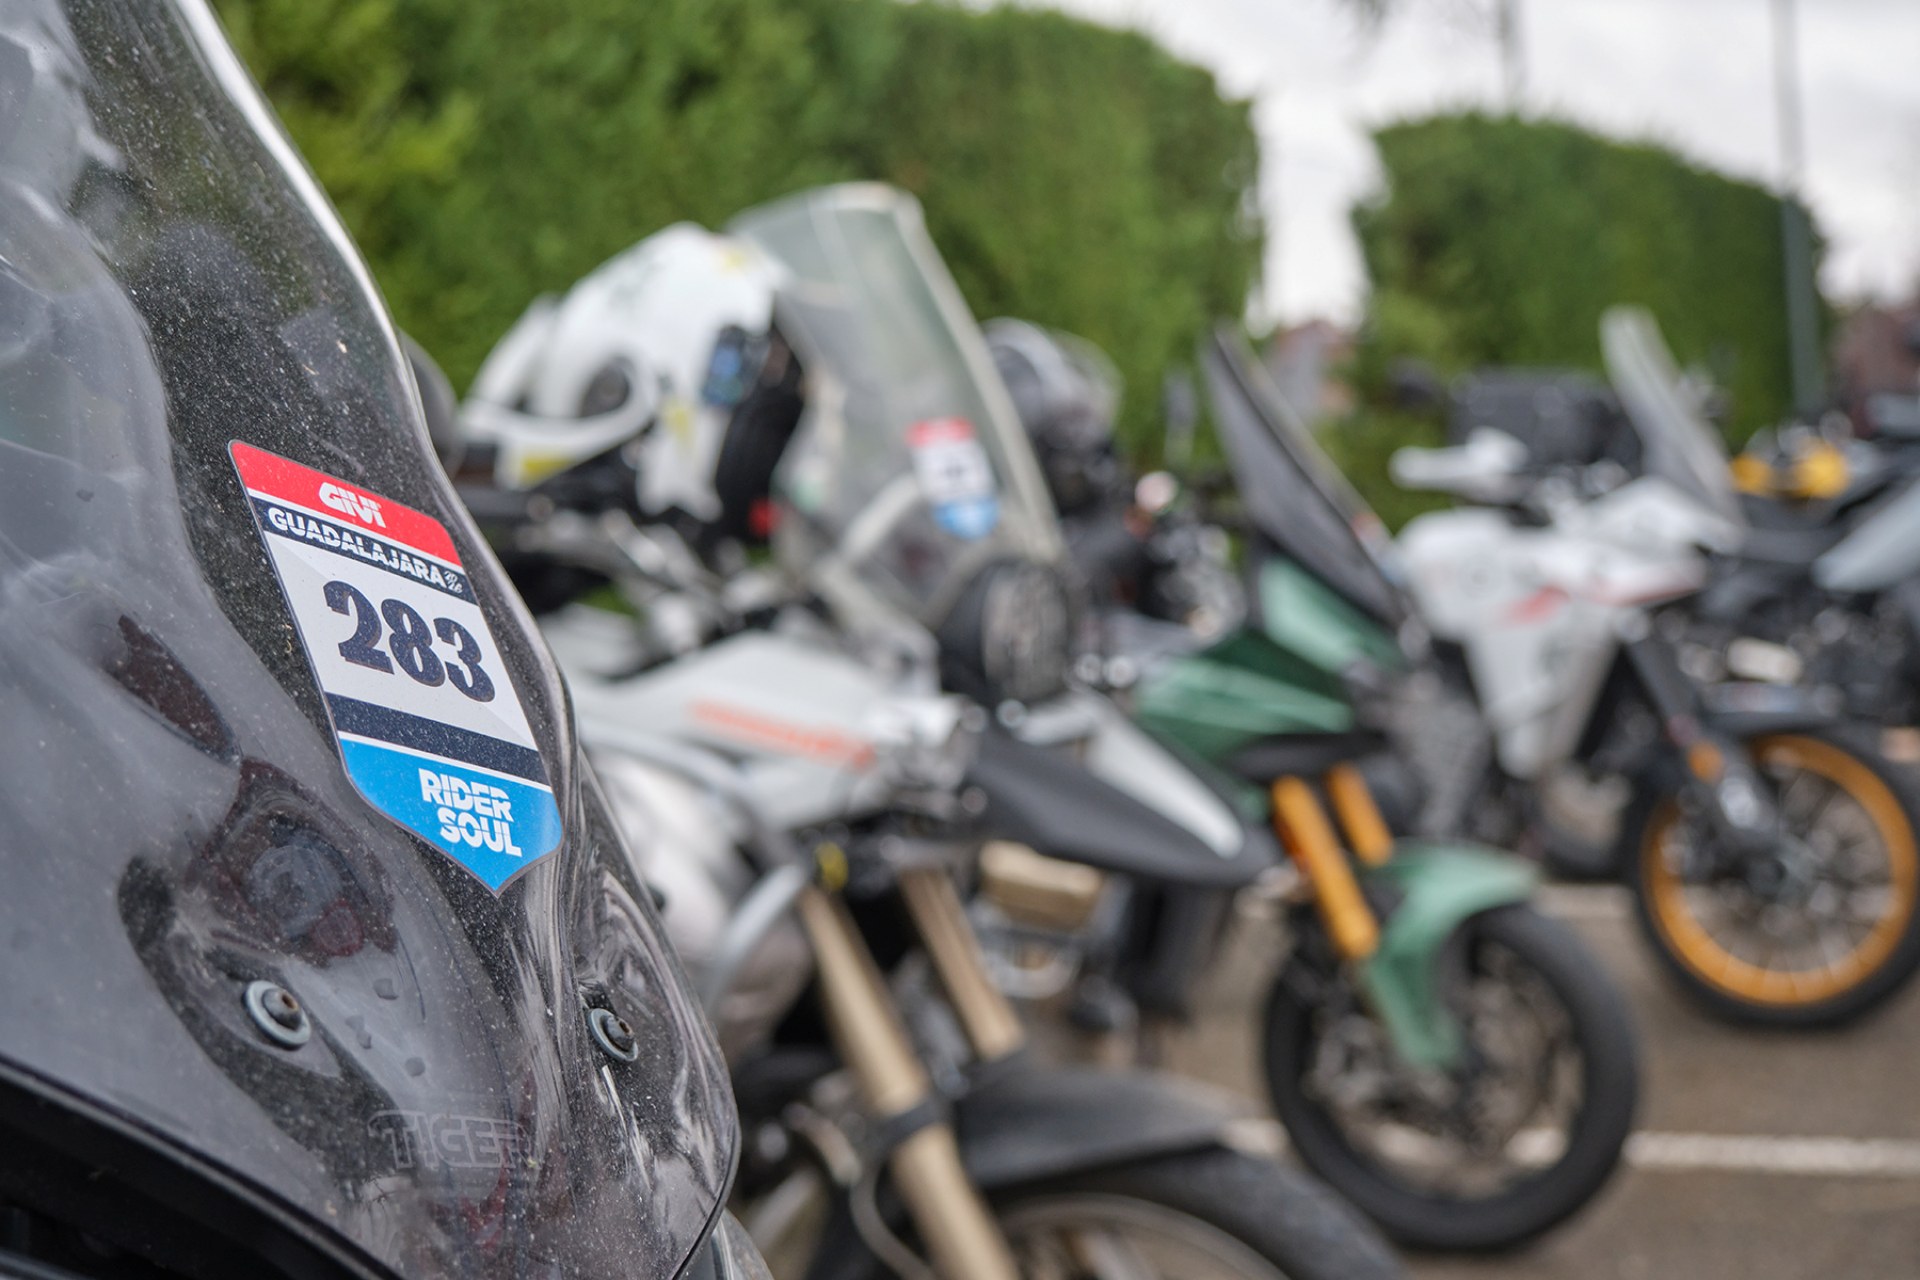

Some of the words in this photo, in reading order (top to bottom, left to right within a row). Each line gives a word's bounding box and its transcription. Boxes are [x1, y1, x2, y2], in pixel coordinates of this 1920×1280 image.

[319, 482, 387, 529] GIVI
[268, 507, 447, 589] GUADALAJARA
[323, 580, 496, 702] 283
[418, 767, 514, 823] RIDER
[437, 807, 522, 857] SOUL
[367, 1110, 542, 1169] TIGER
